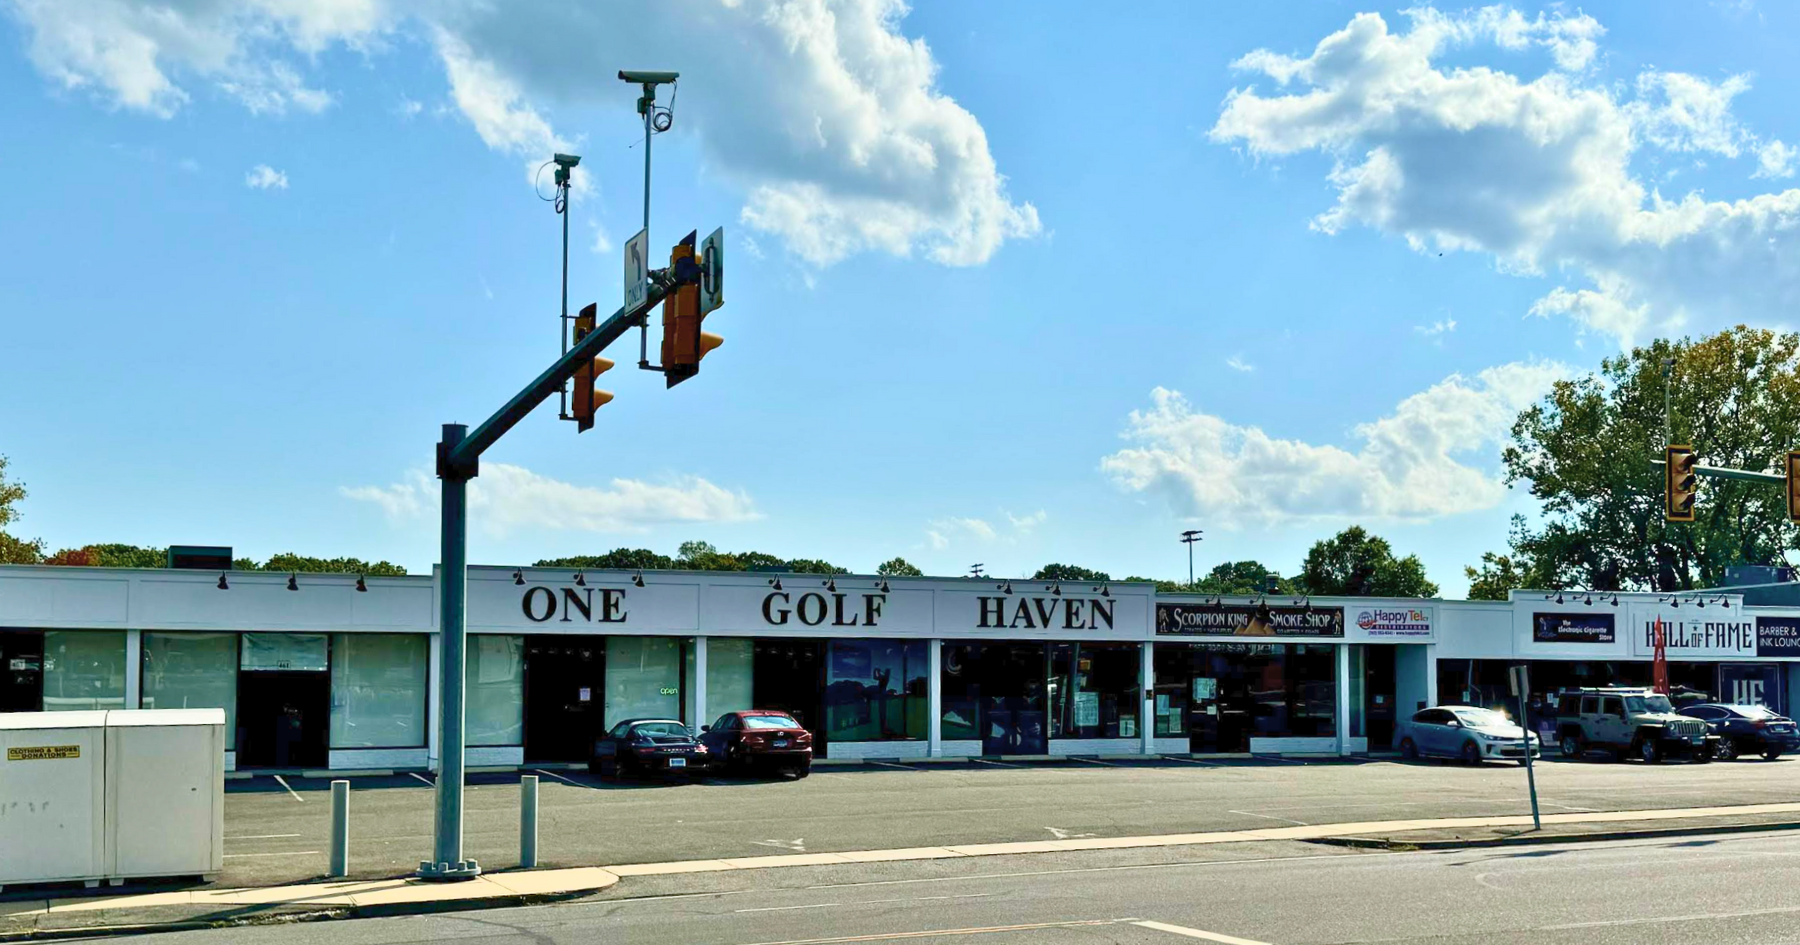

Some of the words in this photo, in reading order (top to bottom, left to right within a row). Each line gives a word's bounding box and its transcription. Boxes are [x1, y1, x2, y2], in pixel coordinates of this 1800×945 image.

[628, 281, 643, 307] ONLY
[522, 586, 627, 623] ONE
[762, 592, 887, 626] GOLF
[976, 596, 1117, 630] HAVEN
[1172, 608, 1225, 632] SCORPION
[1227, 613, 1248, 627] KING
[1269, 611, 1304, 627] SMOKE
[1305, 612, 1331, 627] SHOP
[1584, 626, 1607, 634] Cigarette
[1691, 633, 1704, 648] OF
[1705, 622, 1752, 652] FAME
[1759, 626, 1790, 636] BARBER
[1791, 627, 1797, 636] &
[1760, 637, 1774, 647] INK
